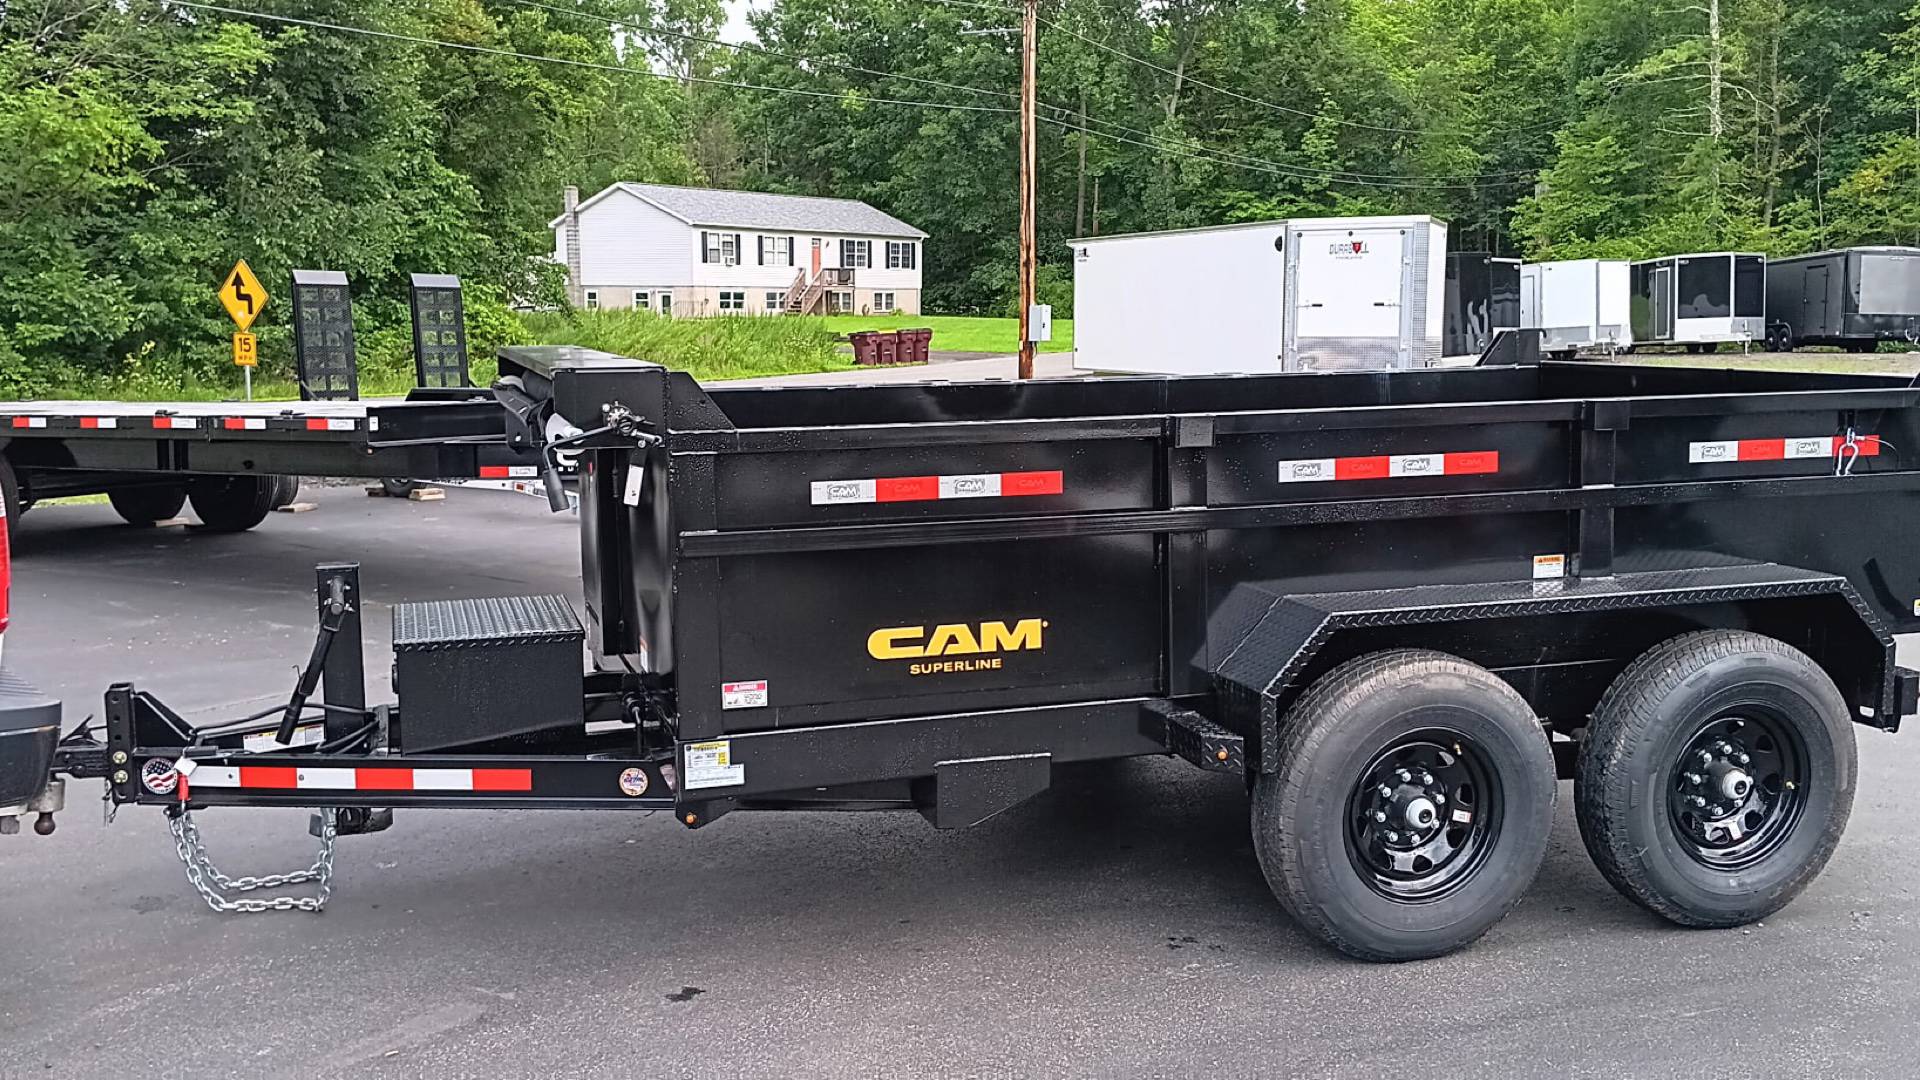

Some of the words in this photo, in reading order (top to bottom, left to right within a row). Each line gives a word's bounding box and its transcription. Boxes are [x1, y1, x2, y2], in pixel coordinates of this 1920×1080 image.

[238, 337, 252, 353] 15
[1295, 465, 1319, 475] CAM
[828, 486, 857, 497] CAM
[956, 480, 983, 490] CAM
[867, 618, 1043, 660] CAM
[909, 658, 1002, 675] SUPERLINE
